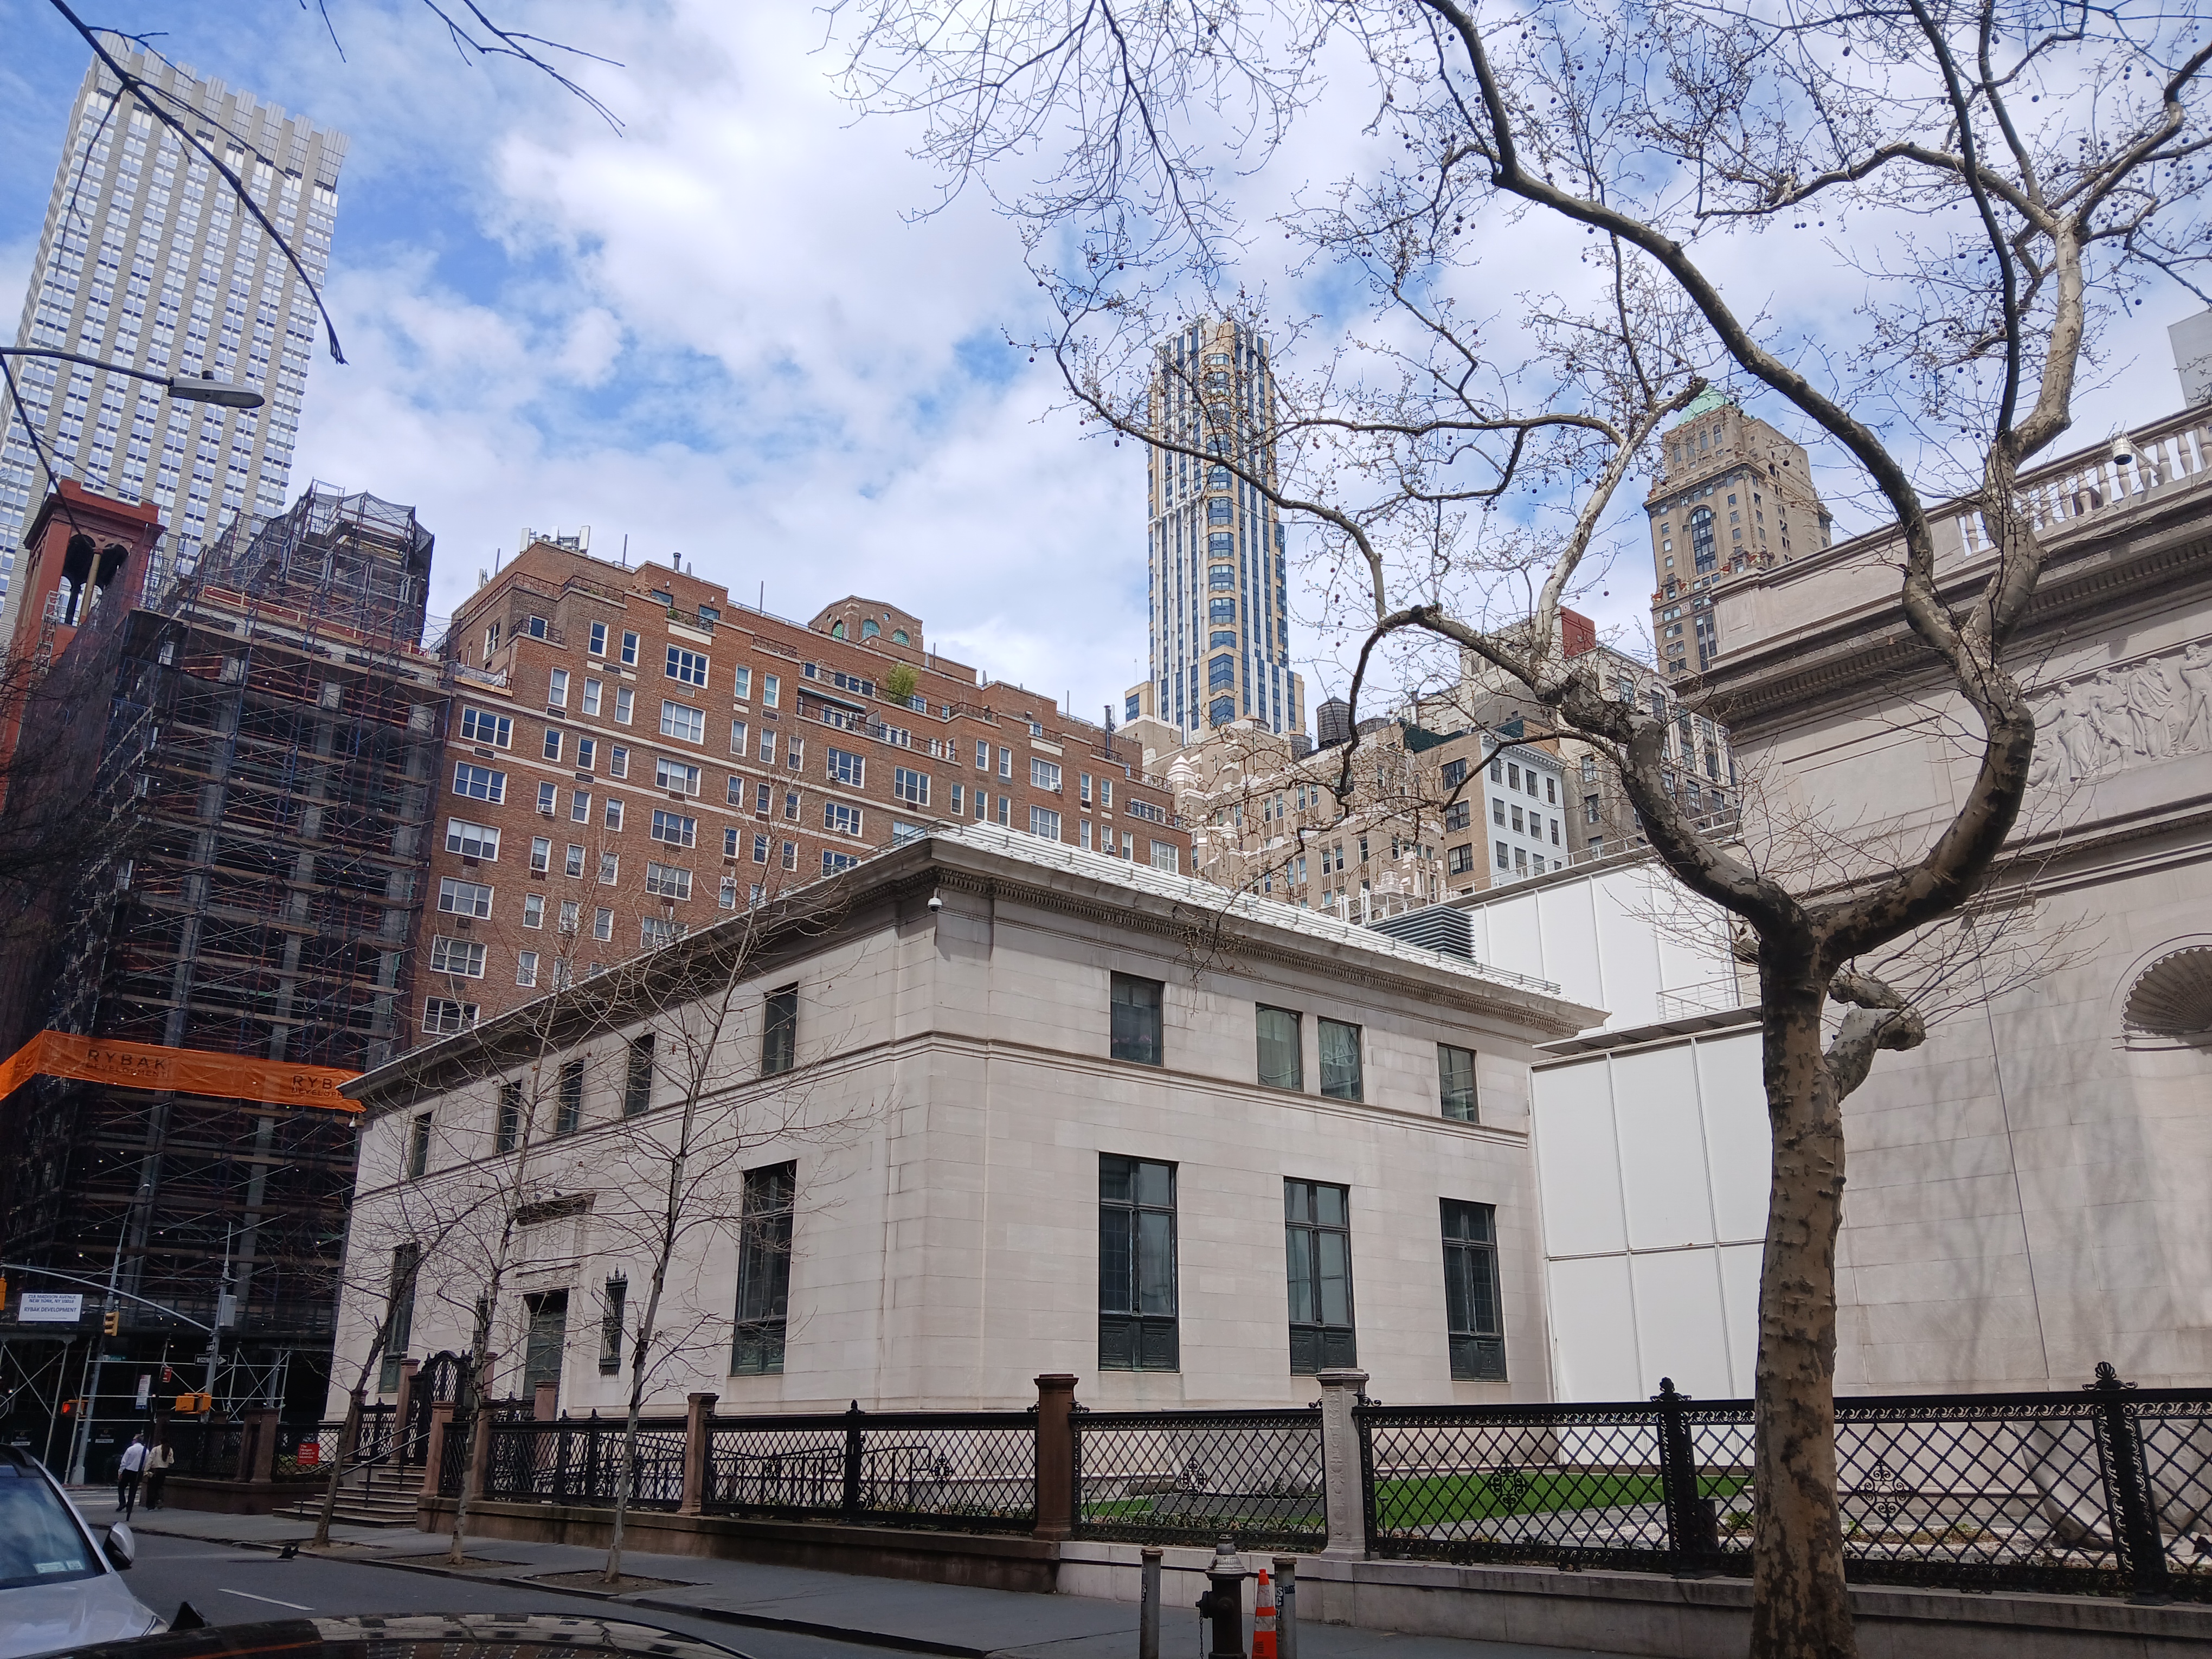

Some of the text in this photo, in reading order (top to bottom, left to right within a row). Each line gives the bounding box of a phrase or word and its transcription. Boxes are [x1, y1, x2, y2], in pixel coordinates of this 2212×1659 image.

[88, 1050, 166, 1069] RYBAK
[86, 1063, 166, 1077] DEVELOPMENT
[293, 1076, 343, 1089] RYB
